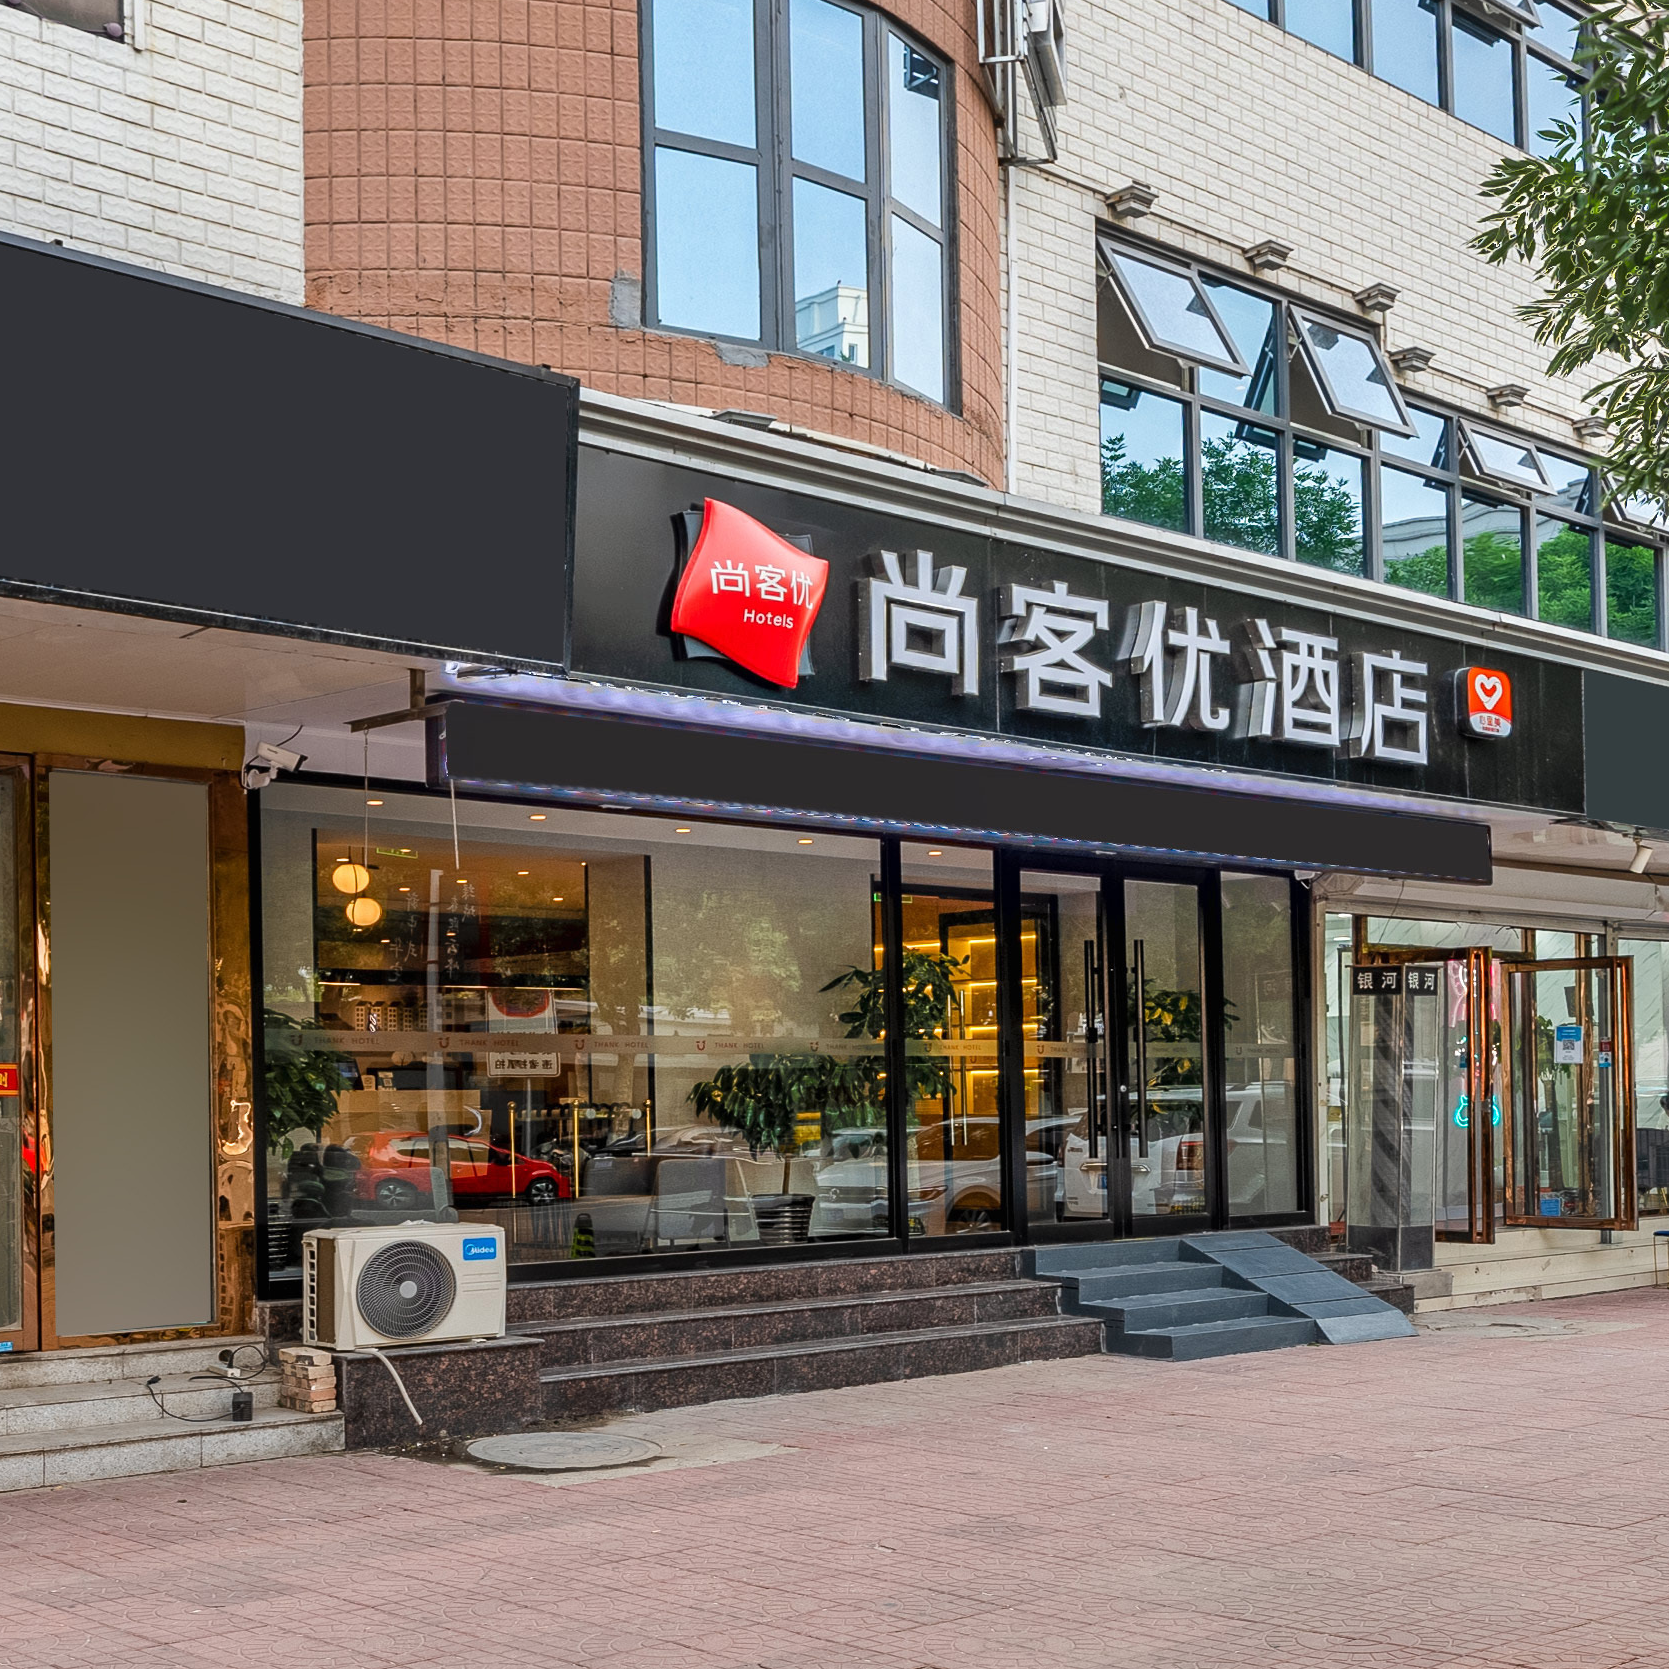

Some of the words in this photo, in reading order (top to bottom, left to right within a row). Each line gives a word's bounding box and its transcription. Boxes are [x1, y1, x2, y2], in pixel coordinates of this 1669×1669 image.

[710, 559, 813, 610] 尚客优
[743, 609, 794, 629] Hotels
[861, 549, 1429, 766] 尚客优酒店
[1357, 972, 1397, 989] 银河
[1408, 972, 1435, 990] 银河
[469, 1245, 495, 1254] Midea
